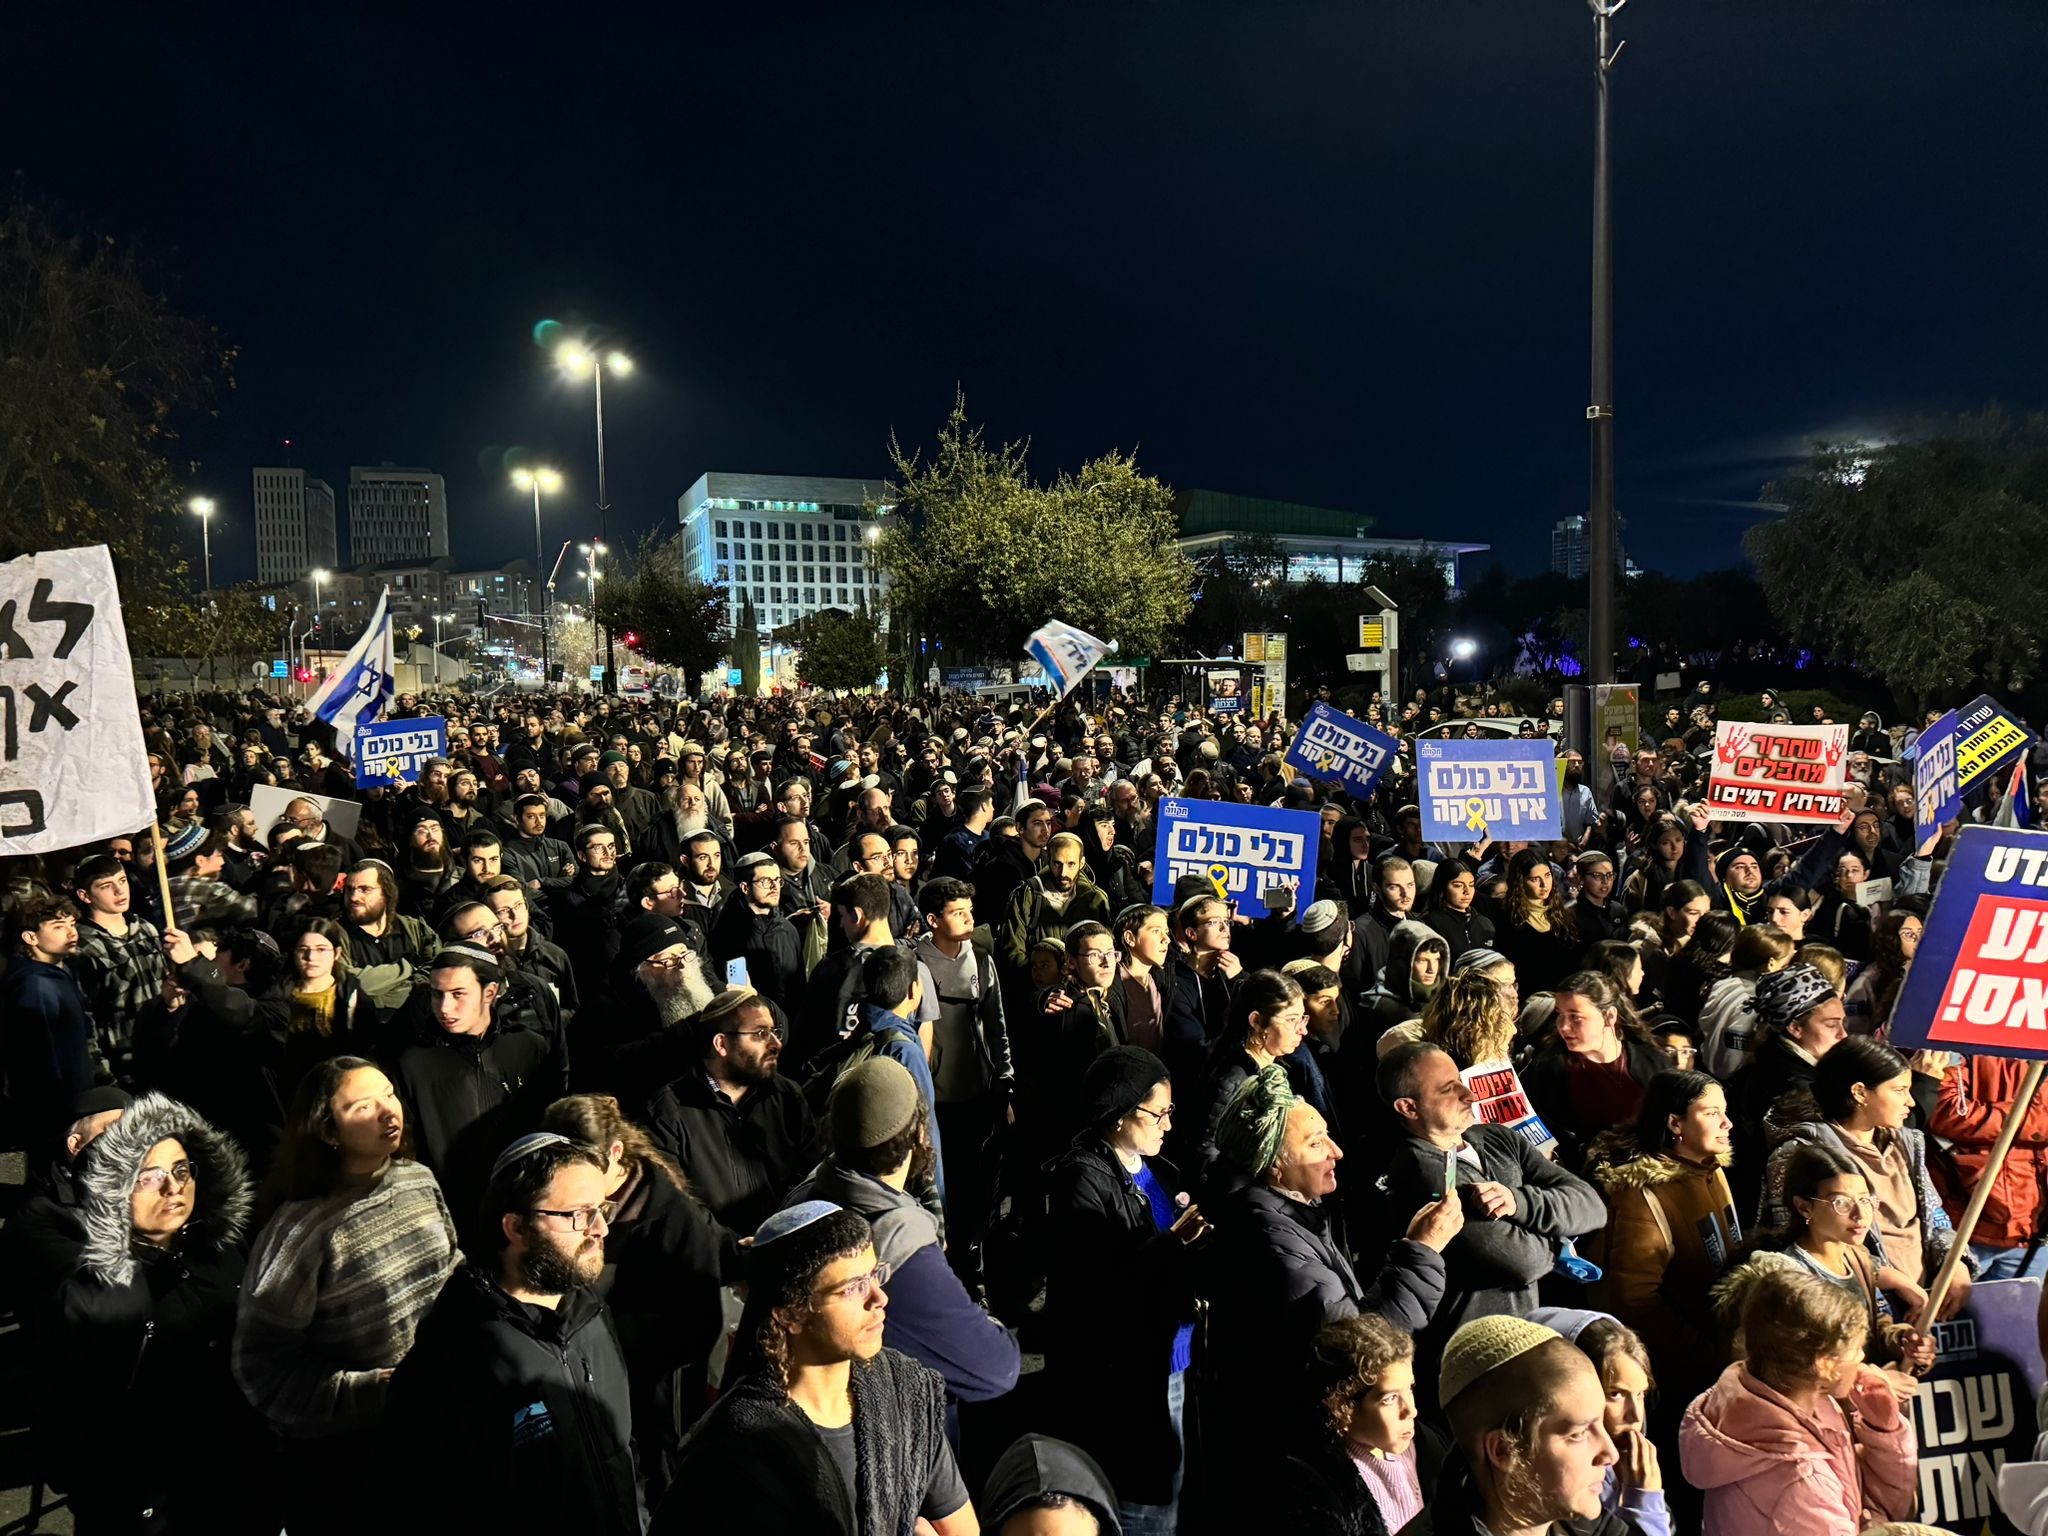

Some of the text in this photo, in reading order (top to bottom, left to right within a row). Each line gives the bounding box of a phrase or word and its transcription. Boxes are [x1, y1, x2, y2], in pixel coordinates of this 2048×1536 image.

[1957, 705, 1994, 732] שחרור
[1989, 721, 2006, 735] רק
[367, 733, 433, 755] בלי כולם
[1312, 723, 1378, 764] בלי כולם
[1751, 735, 1823, 759] שחרור
[1964, 731, 1990, 751] מתוך
[1977, 730, 2022, 763] והכנעת
[1344, 761, 1374, 785] אין
[1436, 763, 1538, 790] בלי כולם
[1736, 757, 1827, 783] מחבלים
[1165, 806, 1187, 815] תקווה
[1509, 797, 1547, 825] אין
[1713, 784, 1841, 814] מרחץ דמים!
[1178, 826, 1294, 864] בלי כולם
